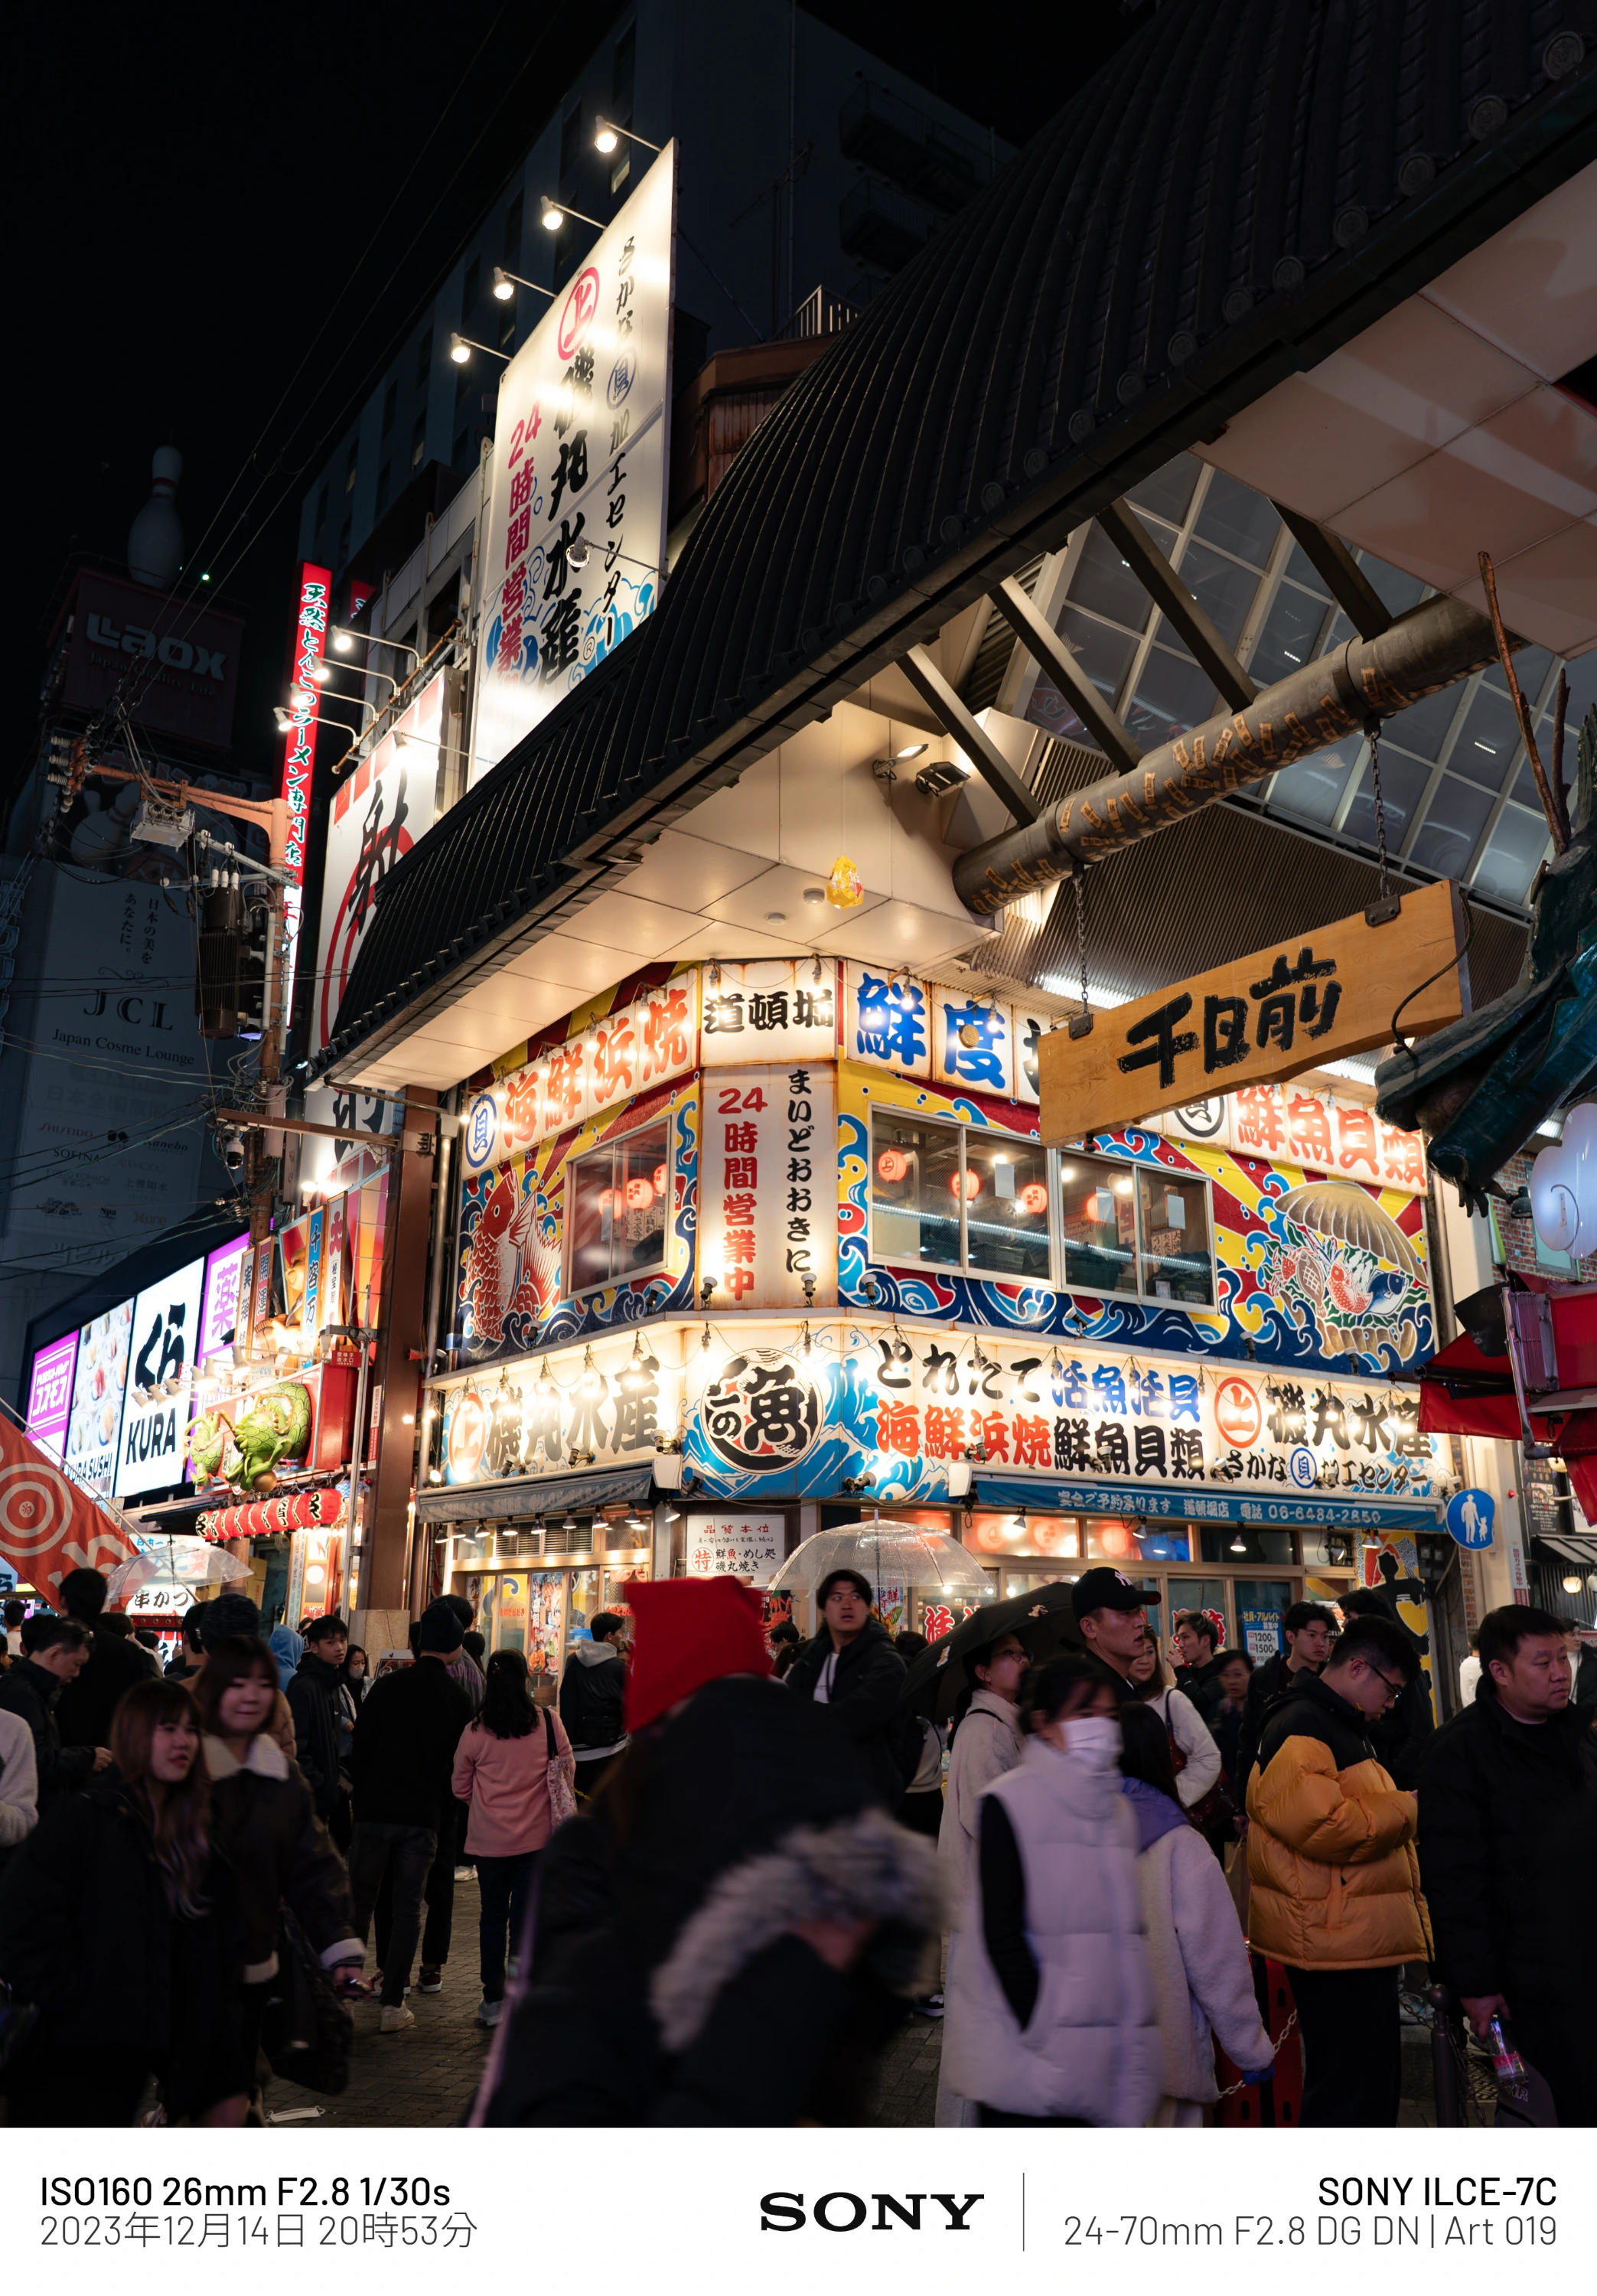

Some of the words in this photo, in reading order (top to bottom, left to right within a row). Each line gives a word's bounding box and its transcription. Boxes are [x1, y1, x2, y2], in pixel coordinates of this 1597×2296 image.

[142, 896, 159, 964] 日本の美を
[704, 988, 834, 1034] 道頓堀
[1117, 947, 1343, 1089] 千日前
[52, 1029, 91, 1047] Japan
[96, 1039, 142, 1055] Cosme
[145, 1045, 194, 1066] Lounge
[504, 989, 688, 1149] 海鮮浜焼
[38, 1122, 94, 1138] SHISEIDO
[54, 1148, 101, 1163] SOFINA
[1236, 1084, 1426, 1187] 鮮魚貝類
[717, 1087, 768, 1301] 24時間営業中
[785, 1070, 815, 1274] まいどおおきに
[32, 1375, 68, 1417] コスモス
[486, 1355, 660, 1470] 磯丸水産
[1266, 1382, 1433, 1459] 磯丸水産
[125, 1407, 176, 1466] KURA
[703, 1523, 771, 1534] 品質本位
[1183, 1499, 1230, 1518] 道頓堀店
[1240, 1502, 1263, 1520] 電話
[1268, 1503, 1381, 1524] 06-6484-2850
[715, 1561, 760, 1573] 磯丸焼き
